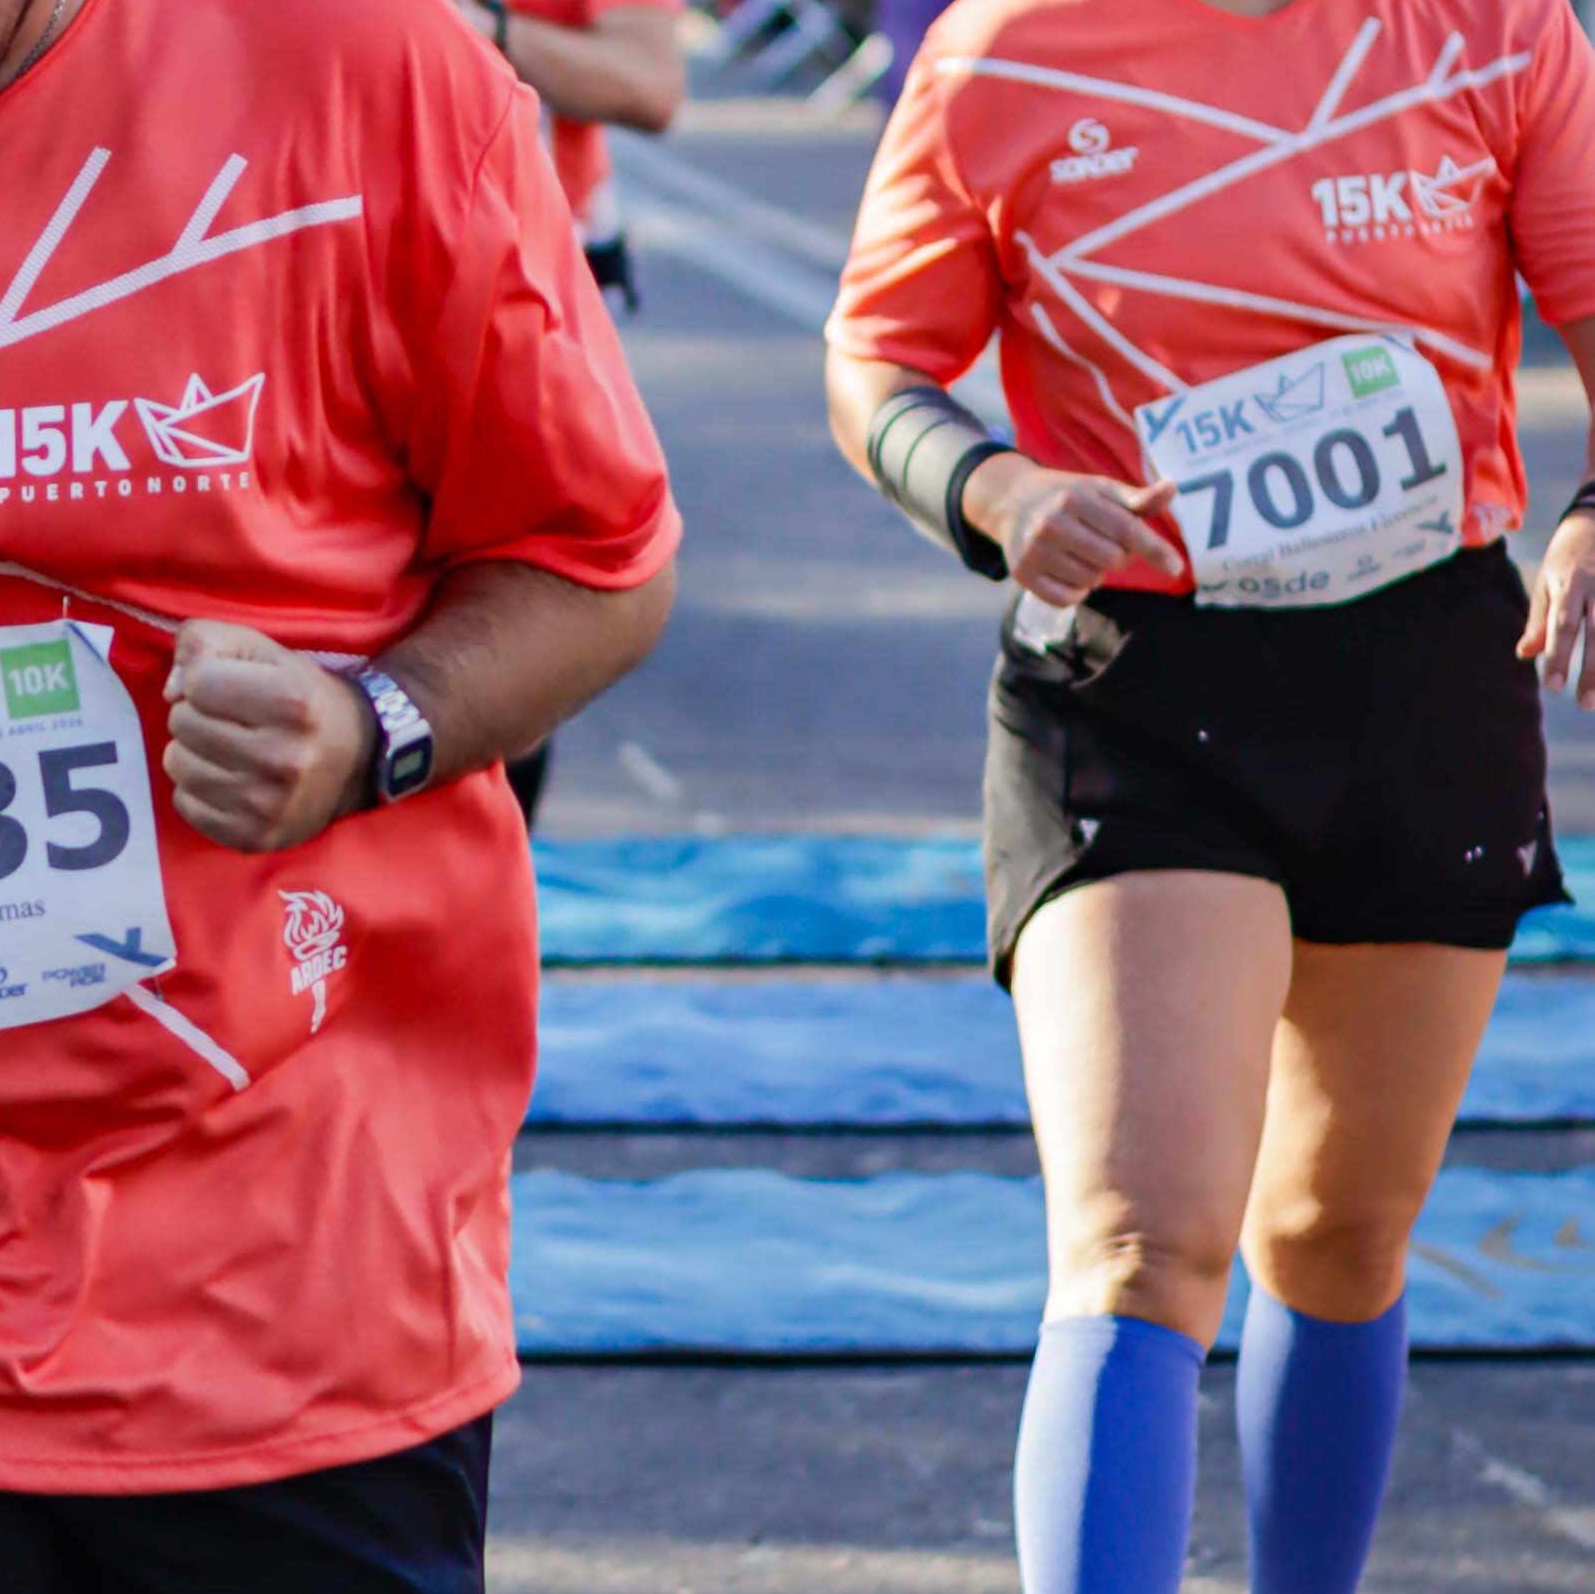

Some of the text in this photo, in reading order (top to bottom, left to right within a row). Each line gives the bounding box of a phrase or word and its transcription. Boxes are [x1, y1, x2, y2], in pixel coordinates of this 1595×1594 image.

[1311, 170, 1413, 228] 15K
[1175, 398, 1255, 453] 15K
[147, 472, 250, 494] NORTE
[1178, 405, 1447, 550] 7001
[8, 660, 70, 697] 10K
